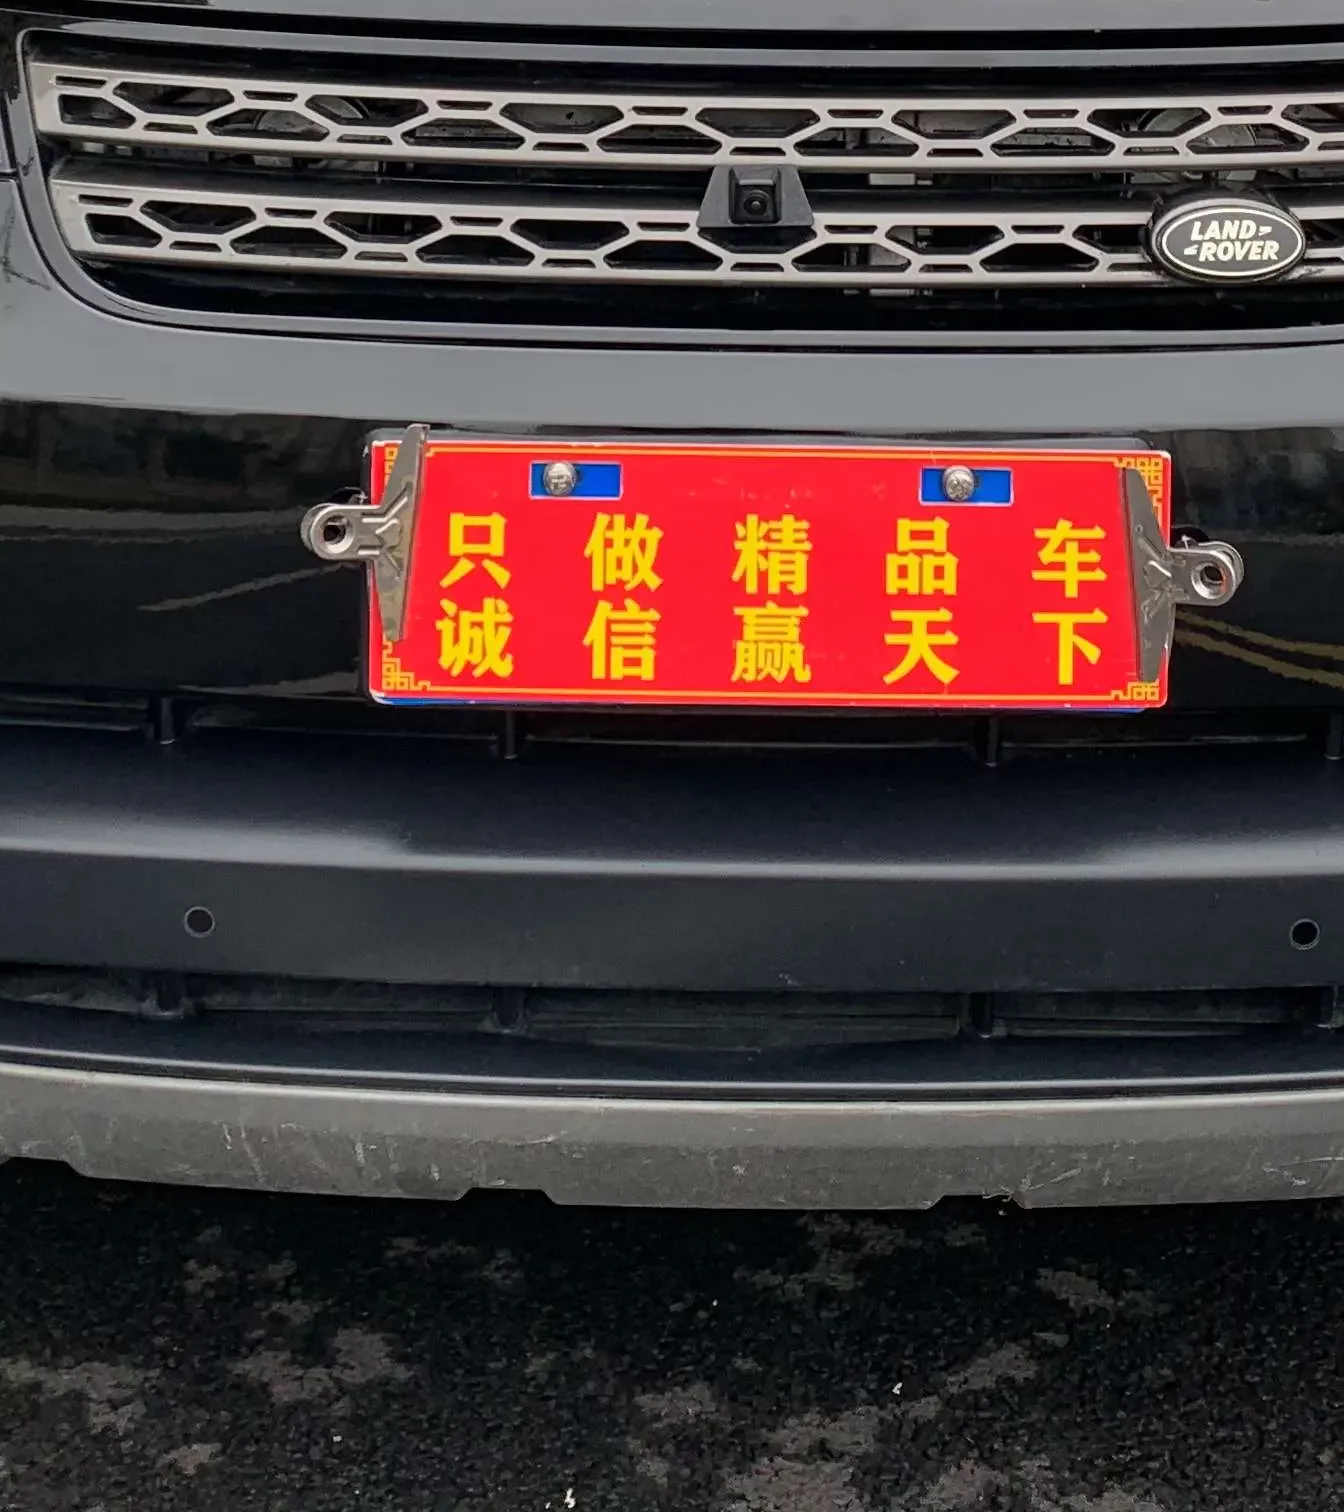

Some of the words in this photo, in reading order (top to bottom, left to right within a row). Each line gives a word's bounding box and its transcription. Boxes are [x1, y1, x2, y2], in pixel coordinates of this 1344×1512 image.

[1190, 219, 1257, 241] LAND
[1198, 239, 1280, 262] ROVER
[437, 512, 1107, 598] 只做精品车
[435, 597, 1108, 685] 诚信赢天下
